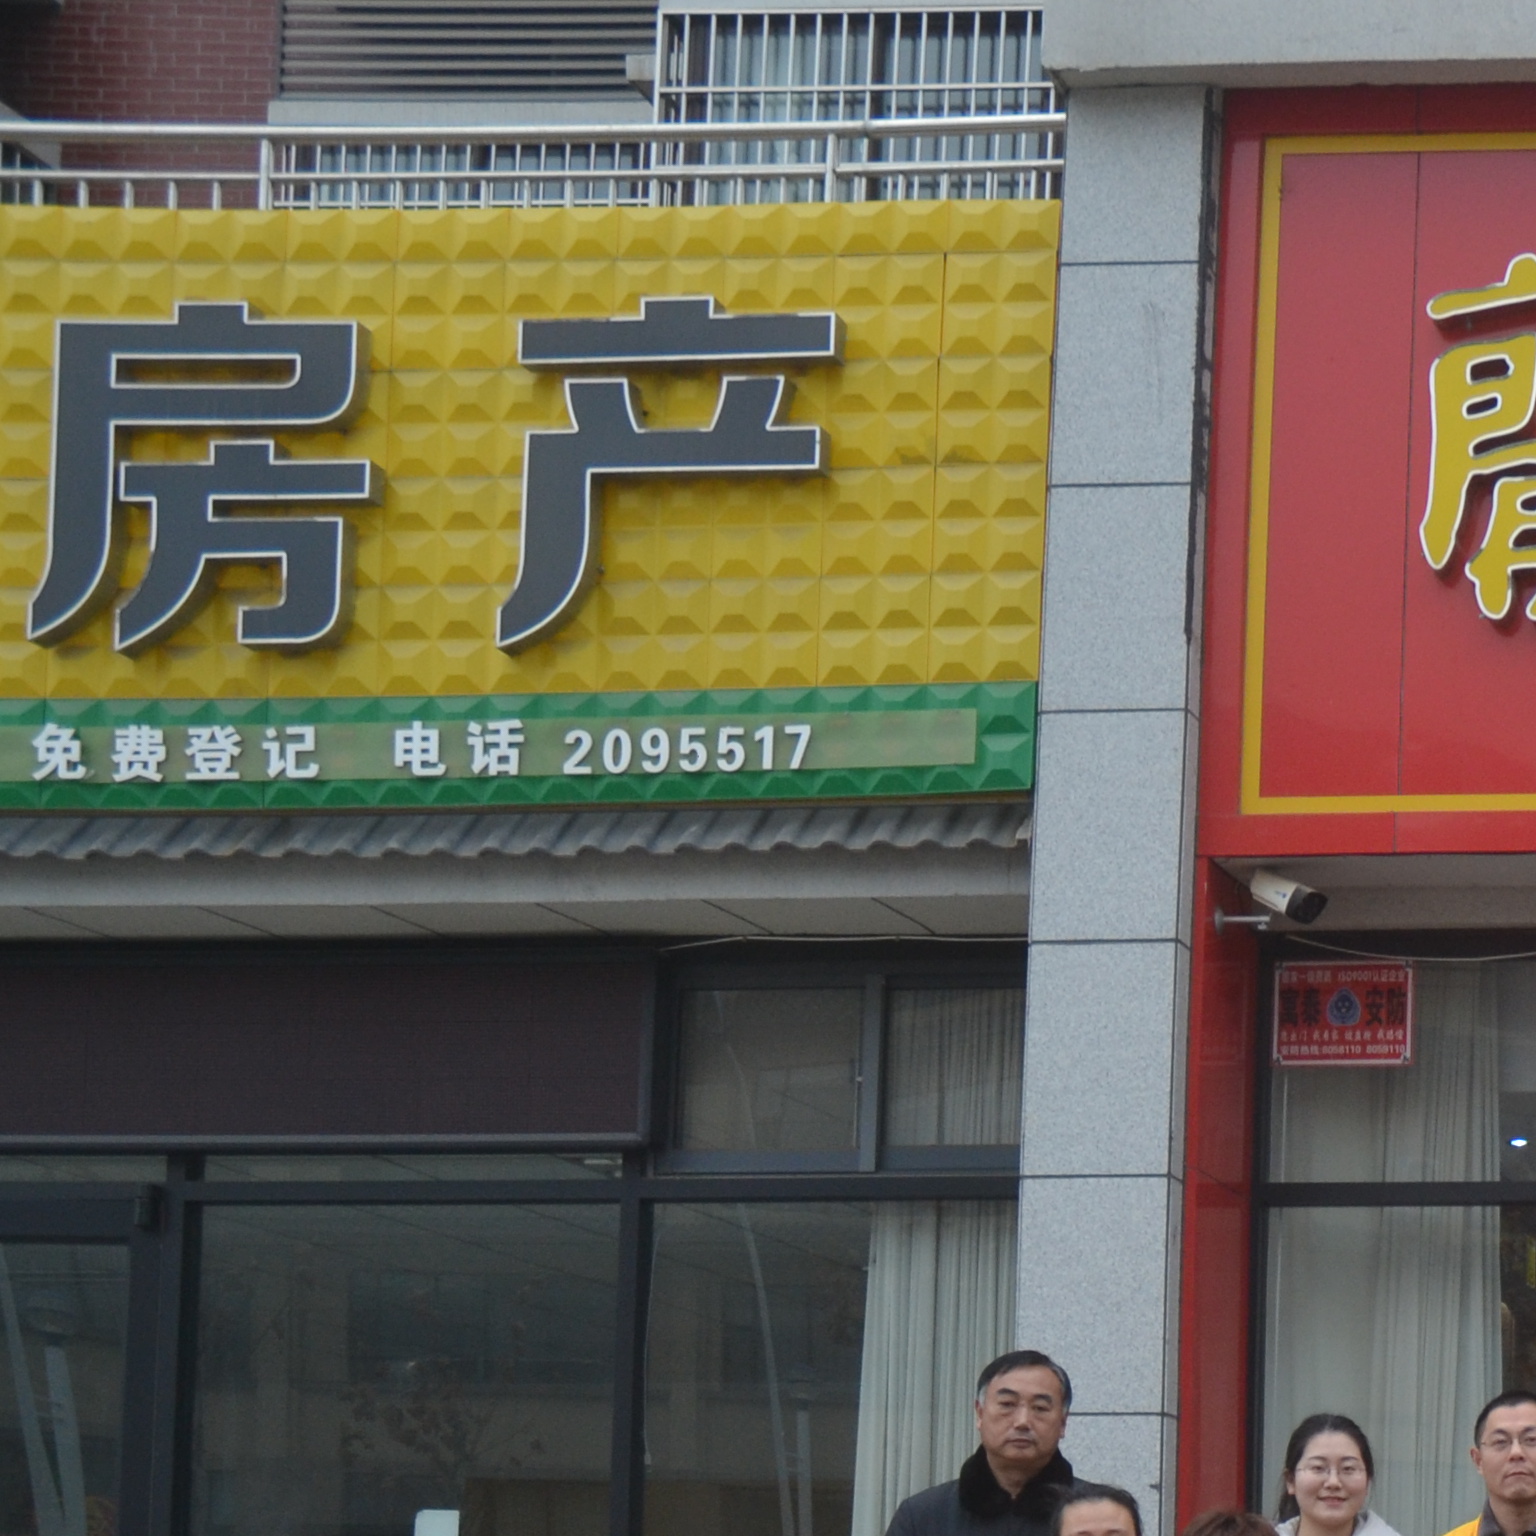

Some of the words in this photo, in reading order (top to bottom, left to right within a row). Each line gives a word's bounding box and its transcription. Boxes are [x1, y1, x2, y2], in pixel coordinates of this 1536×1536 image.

[27, 295, 846, 657] 房产
[32, 723, 320, 782] 免费登记
[394, 719, 525, 776] 电话
[563, 724, 812, 773] 2095517
